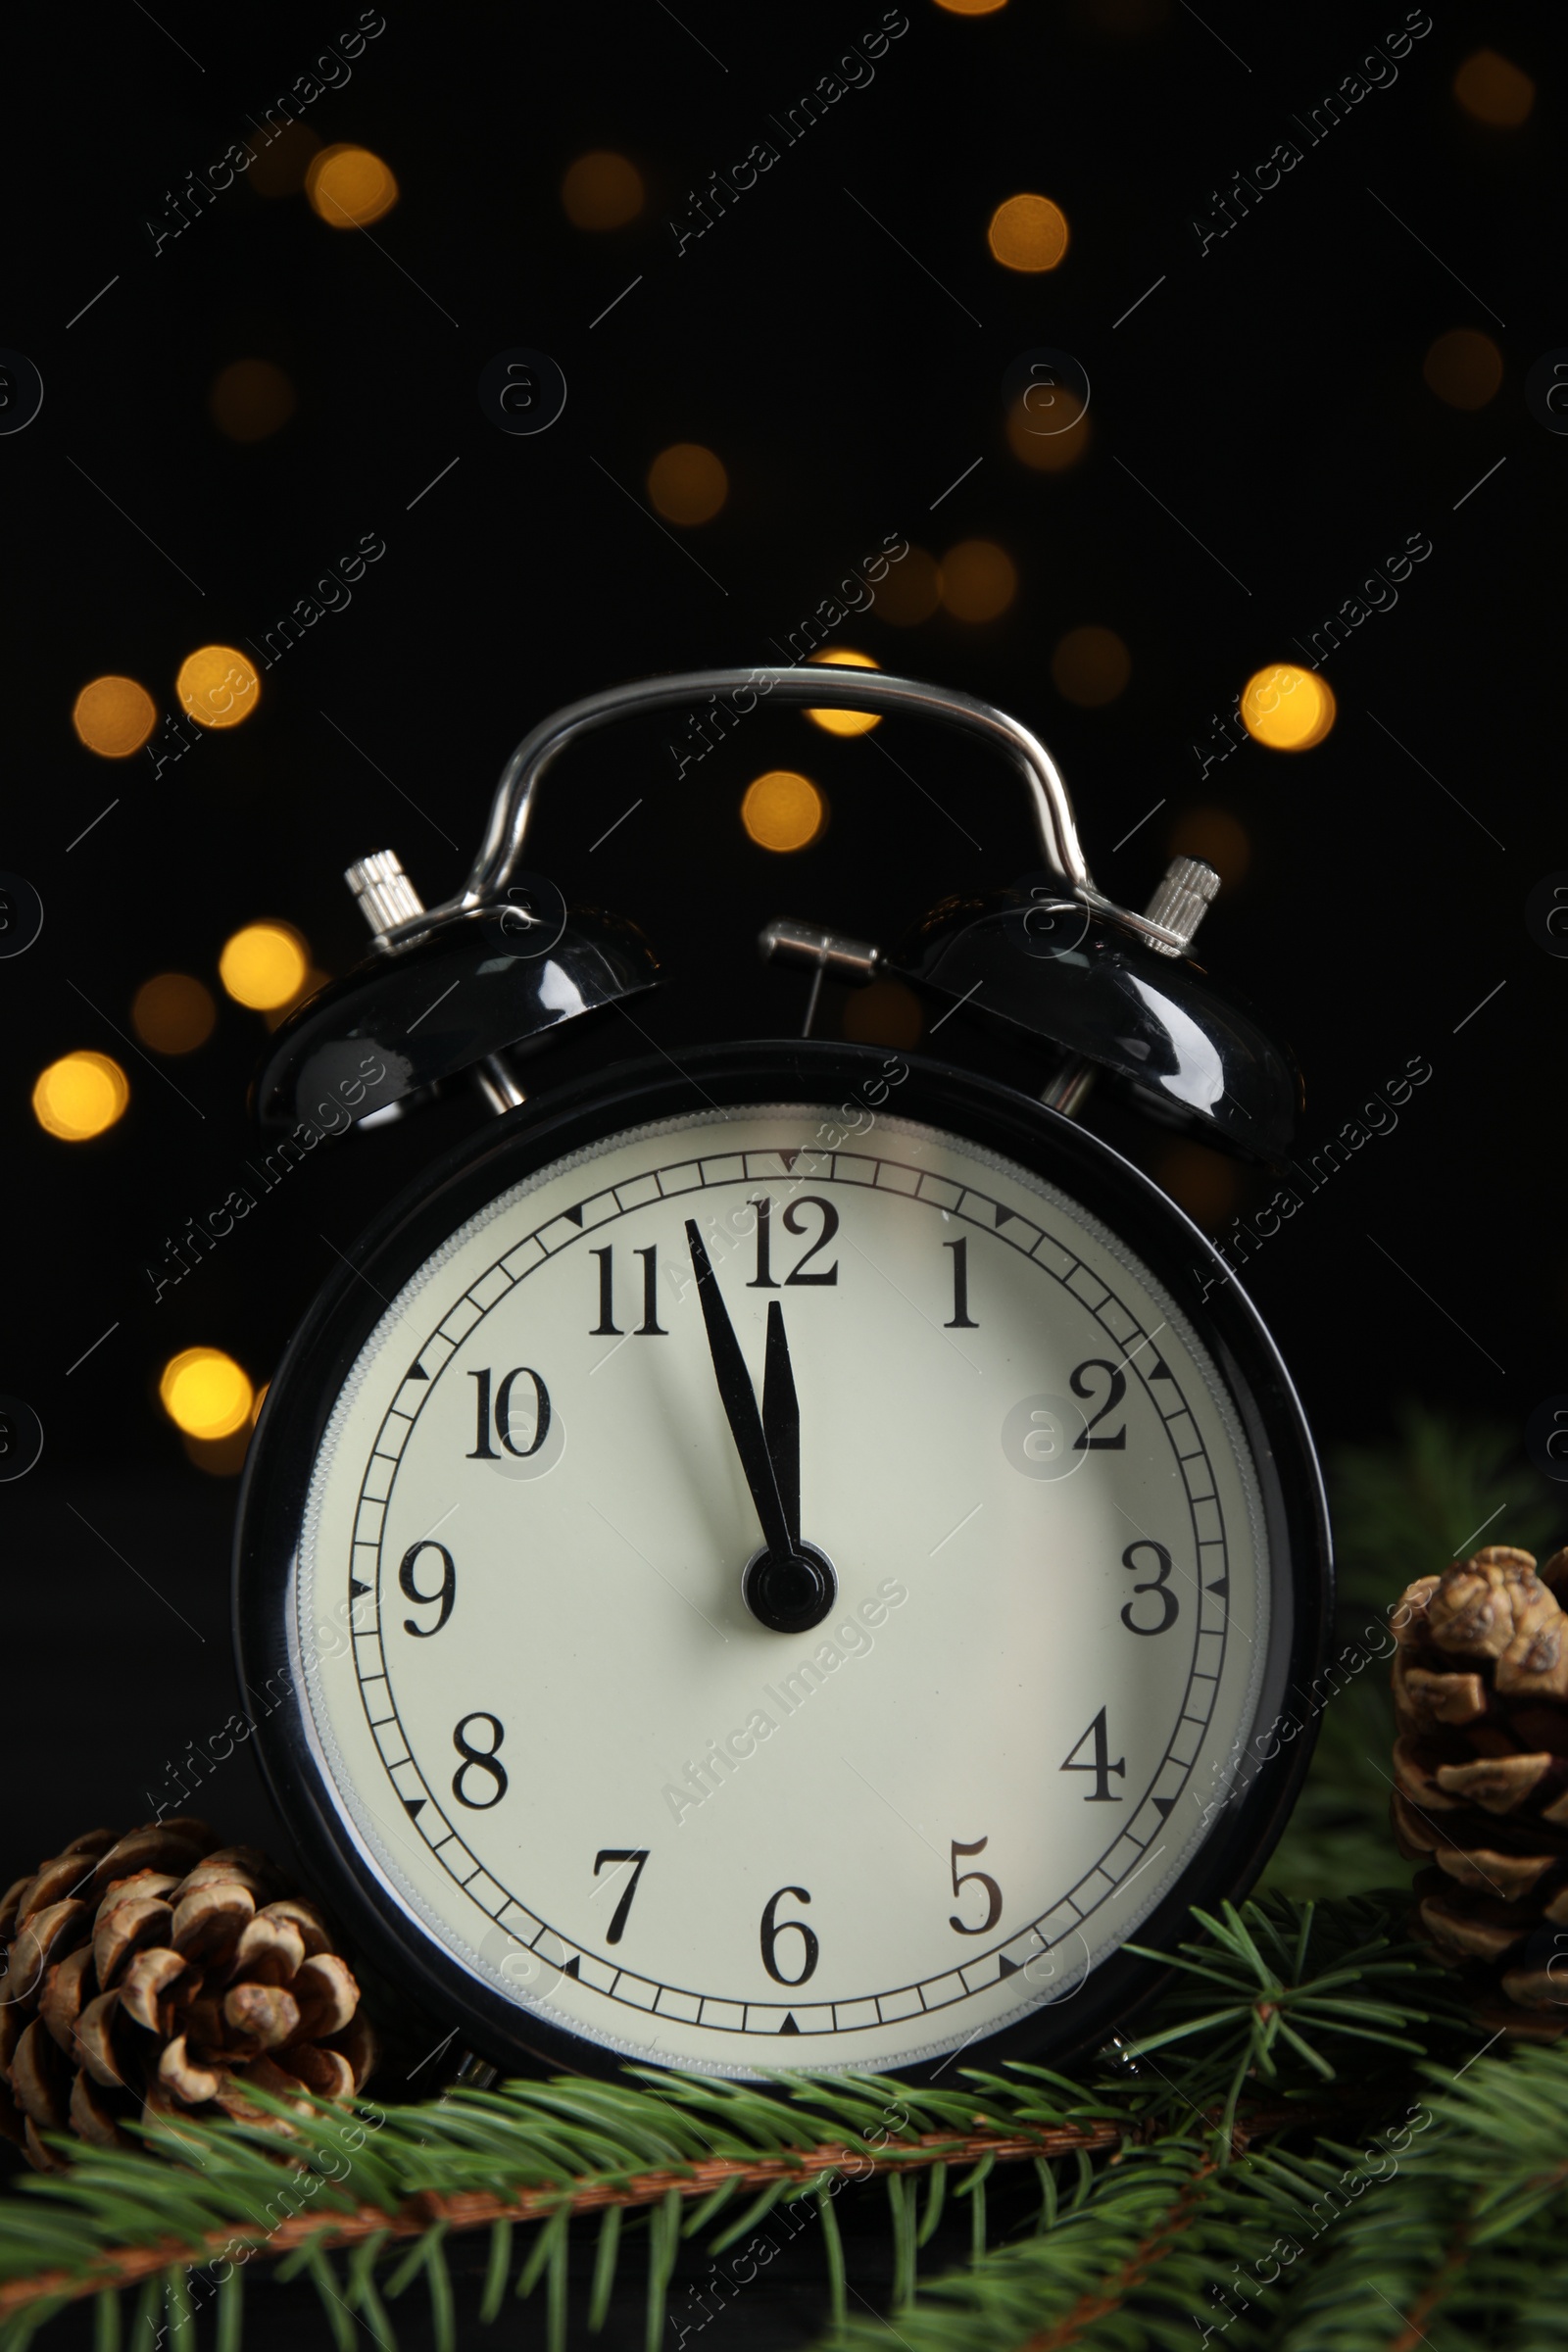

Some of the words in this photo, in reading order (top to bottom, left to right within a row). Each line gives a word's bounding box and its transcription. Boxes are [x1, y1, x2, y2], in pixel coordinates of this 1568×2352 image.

[589, 1244, 668, 1336] 11
[746, 1196, 840, 1288] 12
[943, 1236, 980, 1329] 1
[466, 1366, 551, 1459] 10
[1068, 1358, 1127, 1450] 2
[398, 1541, 457, 1638] 9
[1120, 1541, 1180, 1637] 3
[451, 1712, 509, 1810] 8
[1059, 1705, 1126, 1802] 4
[592, 1849, 651, 1945] 7
[949, 1836, 1004, 1936] 5
[760, 1886, 819, 1986] 6
